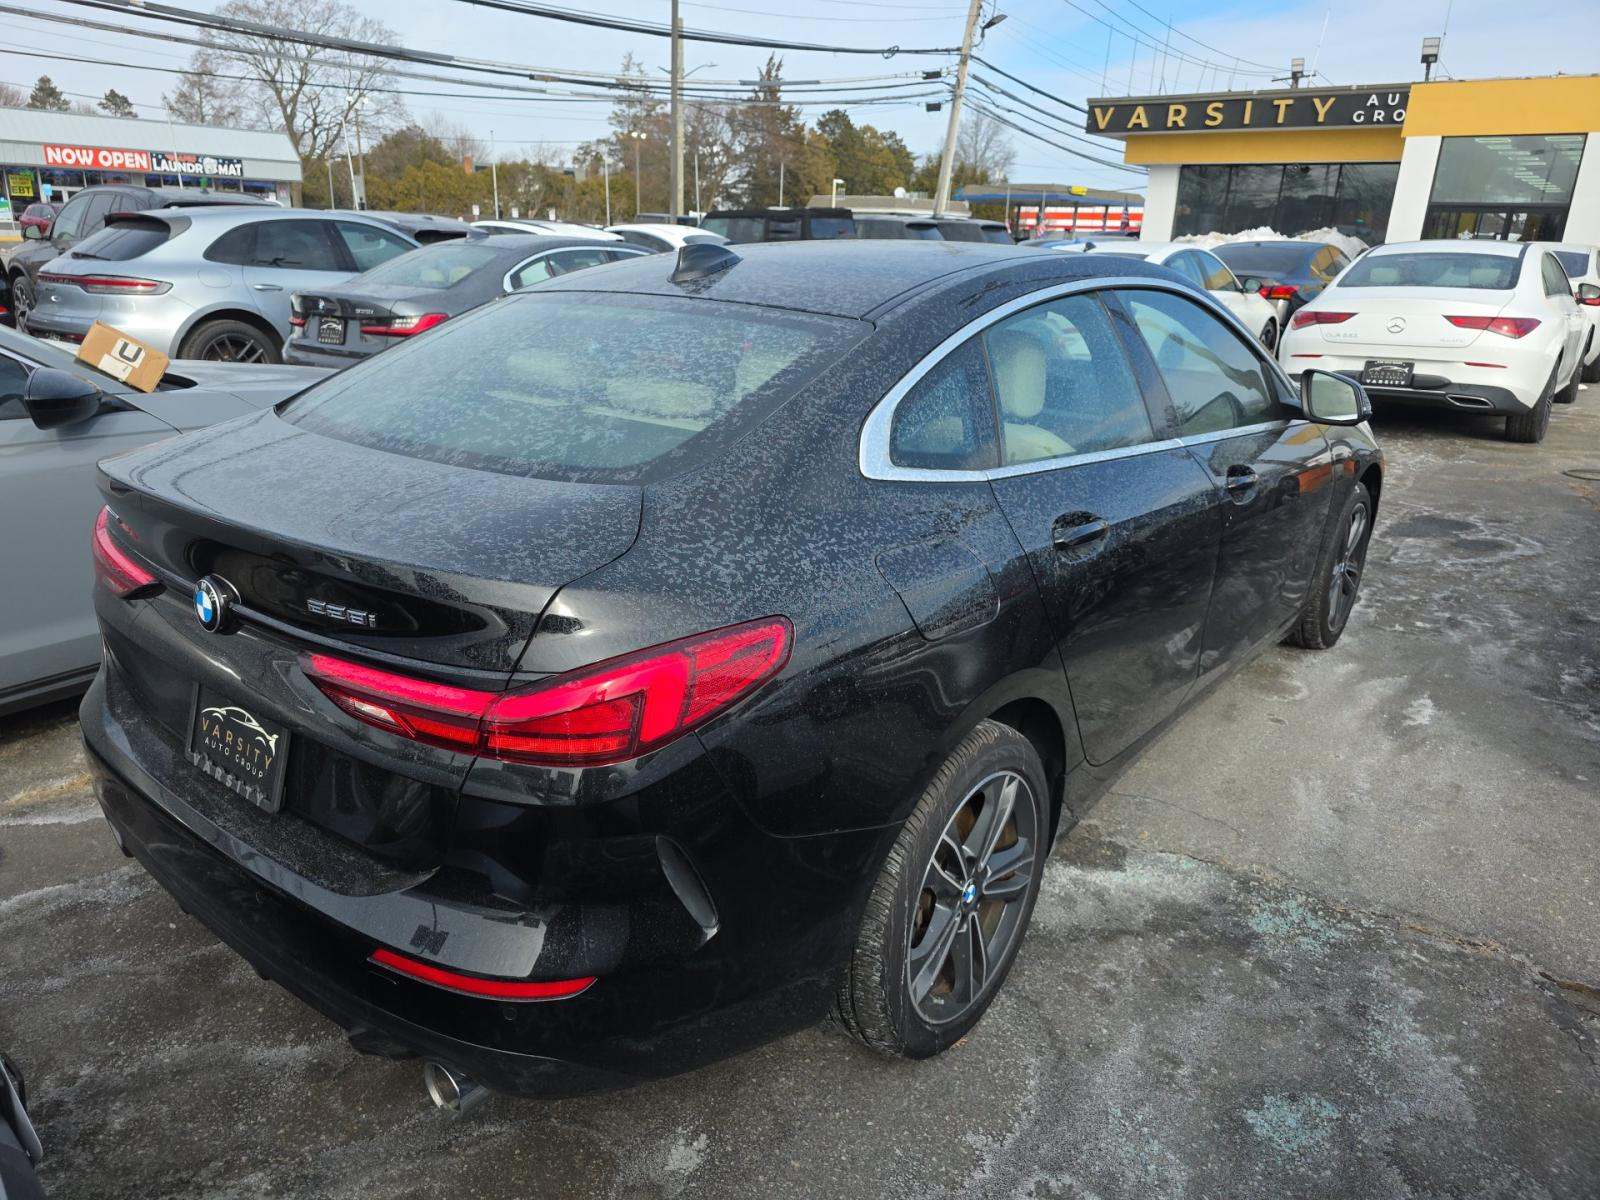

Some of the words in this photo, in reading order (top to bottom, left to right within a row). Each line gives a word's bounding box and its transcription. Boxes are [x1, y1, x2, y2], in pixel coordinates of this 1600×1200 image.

[1094, 96, 1336, 130] VARSITY
[1353, 109, 1406, 123] GRO
[1366, 93, 1400, 106] AU
[46, 147, 94, 166] NOW
[98, 150, 148, 169] OPEN
[202, 717, 272, 770] VARSITY
[204, 737, 230, 756] AUTO
[235, 754, 264, 778] GROUP
[193, 751, 264, 806] VARSITY
